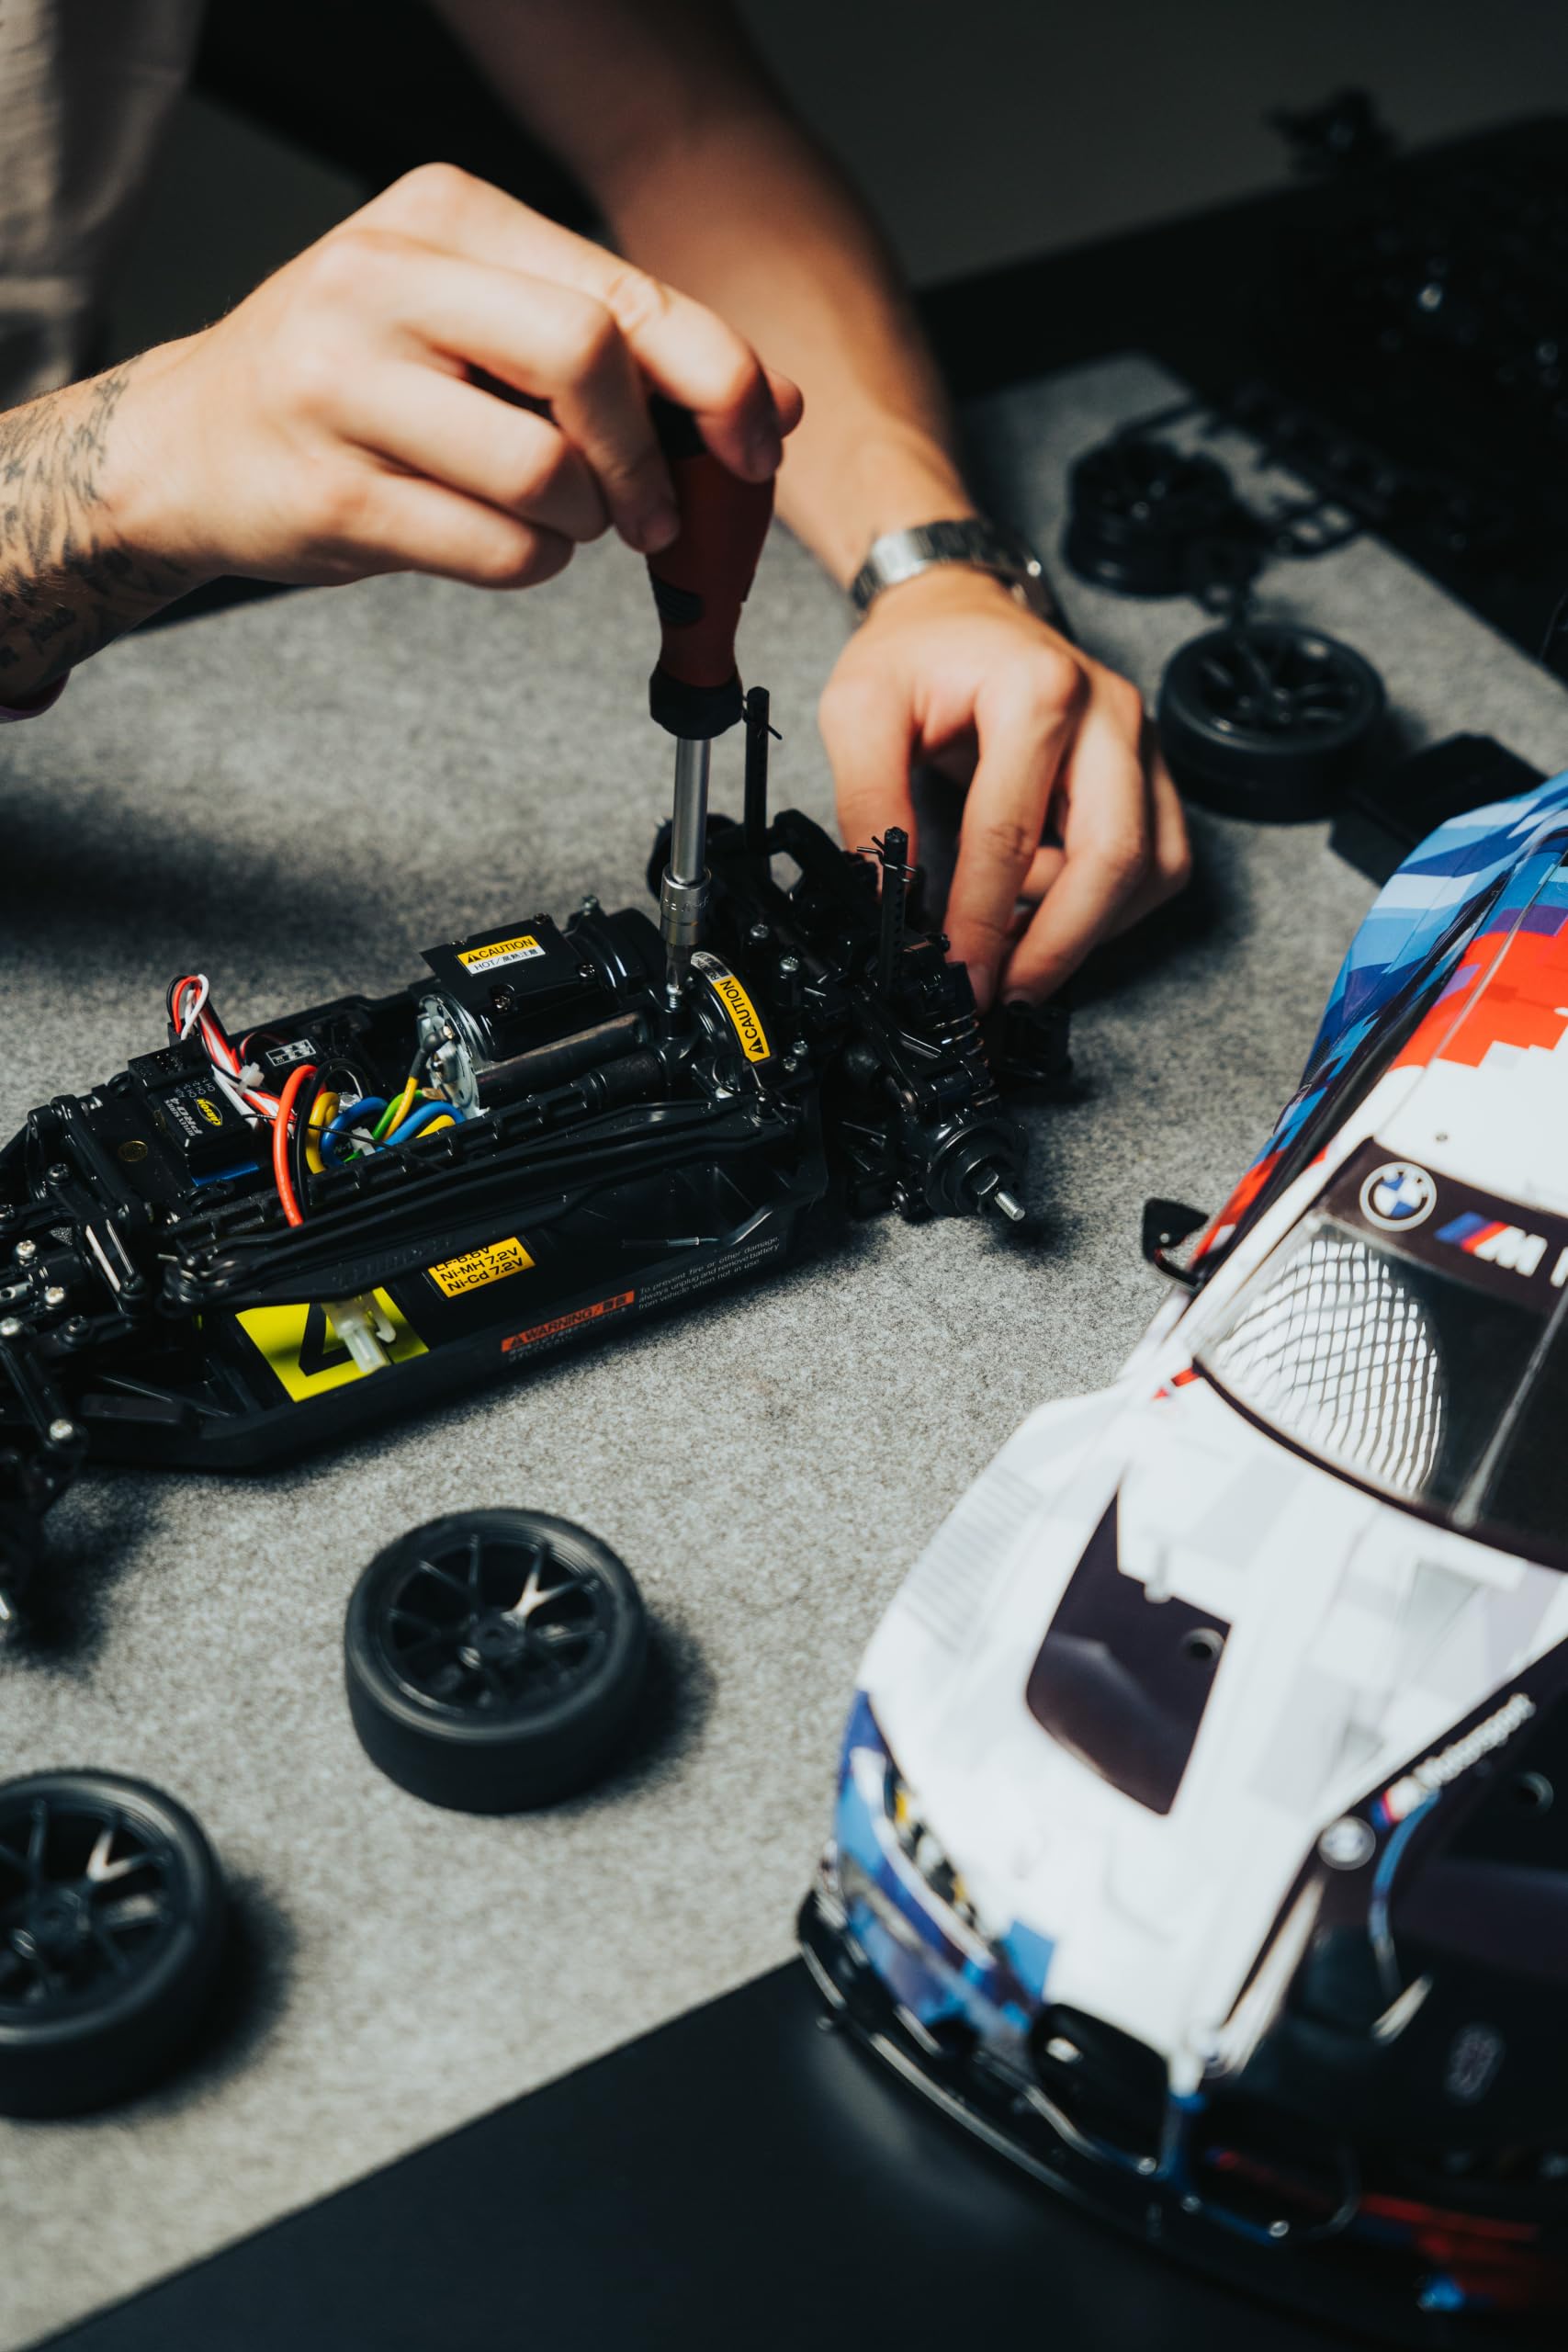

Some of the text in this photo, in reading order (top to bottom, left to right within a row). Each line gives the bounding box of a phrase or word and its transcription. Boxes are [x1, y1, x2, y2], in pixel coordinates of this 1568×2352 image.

[479, 938, 533, 958] CAUTION
[720, 980, 758, 1039] CAUTION
[176, 1106, 203, 1135] PRO
[196, 1098, 221, 1126] CARSON
[440, 1247, 518, 1282] Ni-MH 7.2V
[671, 1275, 699, 1291] unplug
[701, 1267, 716, 1280] and
[717, 1256, 749, 1272] remove
[750, 1243, 780, 1260] battery
[718, 1251, 740, 1264] other
[446, 1257, 524, 1292] Ni-Cd 7.2V
[693, 1276, 716, 1290] when
[717, 1270, 730, 1280] not
